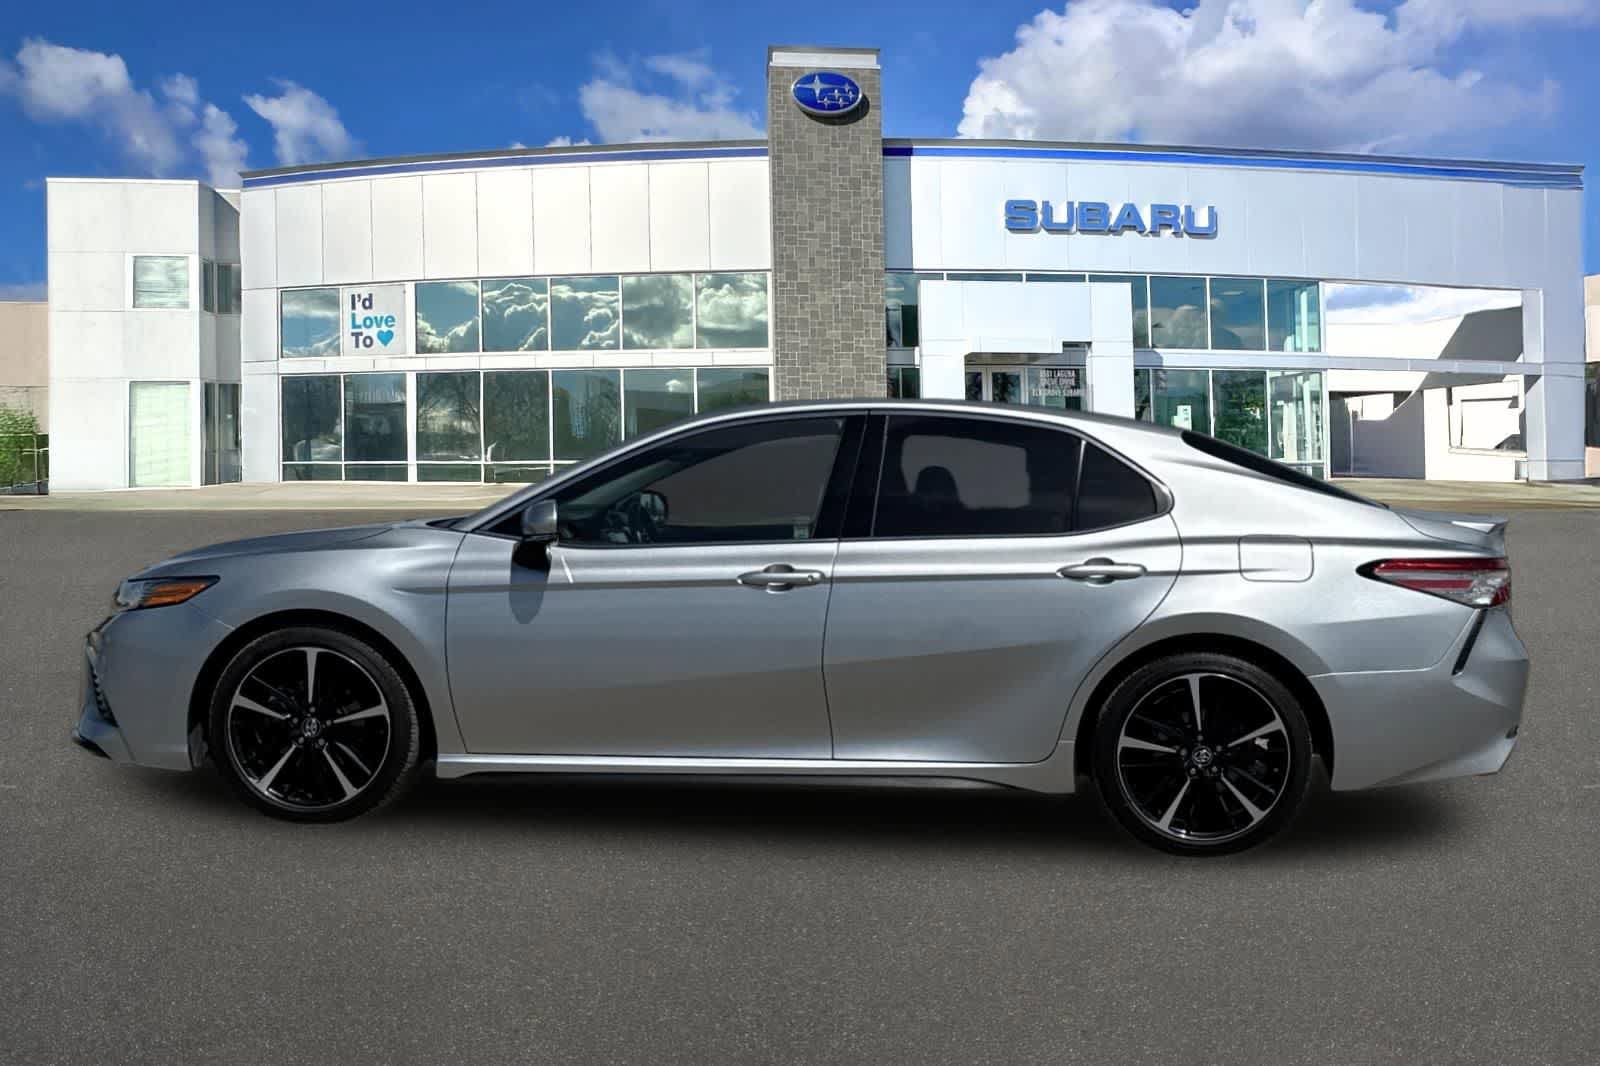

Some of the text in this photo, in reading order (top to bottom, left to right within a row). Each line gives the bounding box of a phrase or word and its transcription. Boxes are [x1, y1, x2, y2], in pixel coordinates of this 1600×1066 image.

[1005, 199, 1217, 238] SUBARU
[351, 312, 396, 329] Love
[351, 331, 374, 348] To
